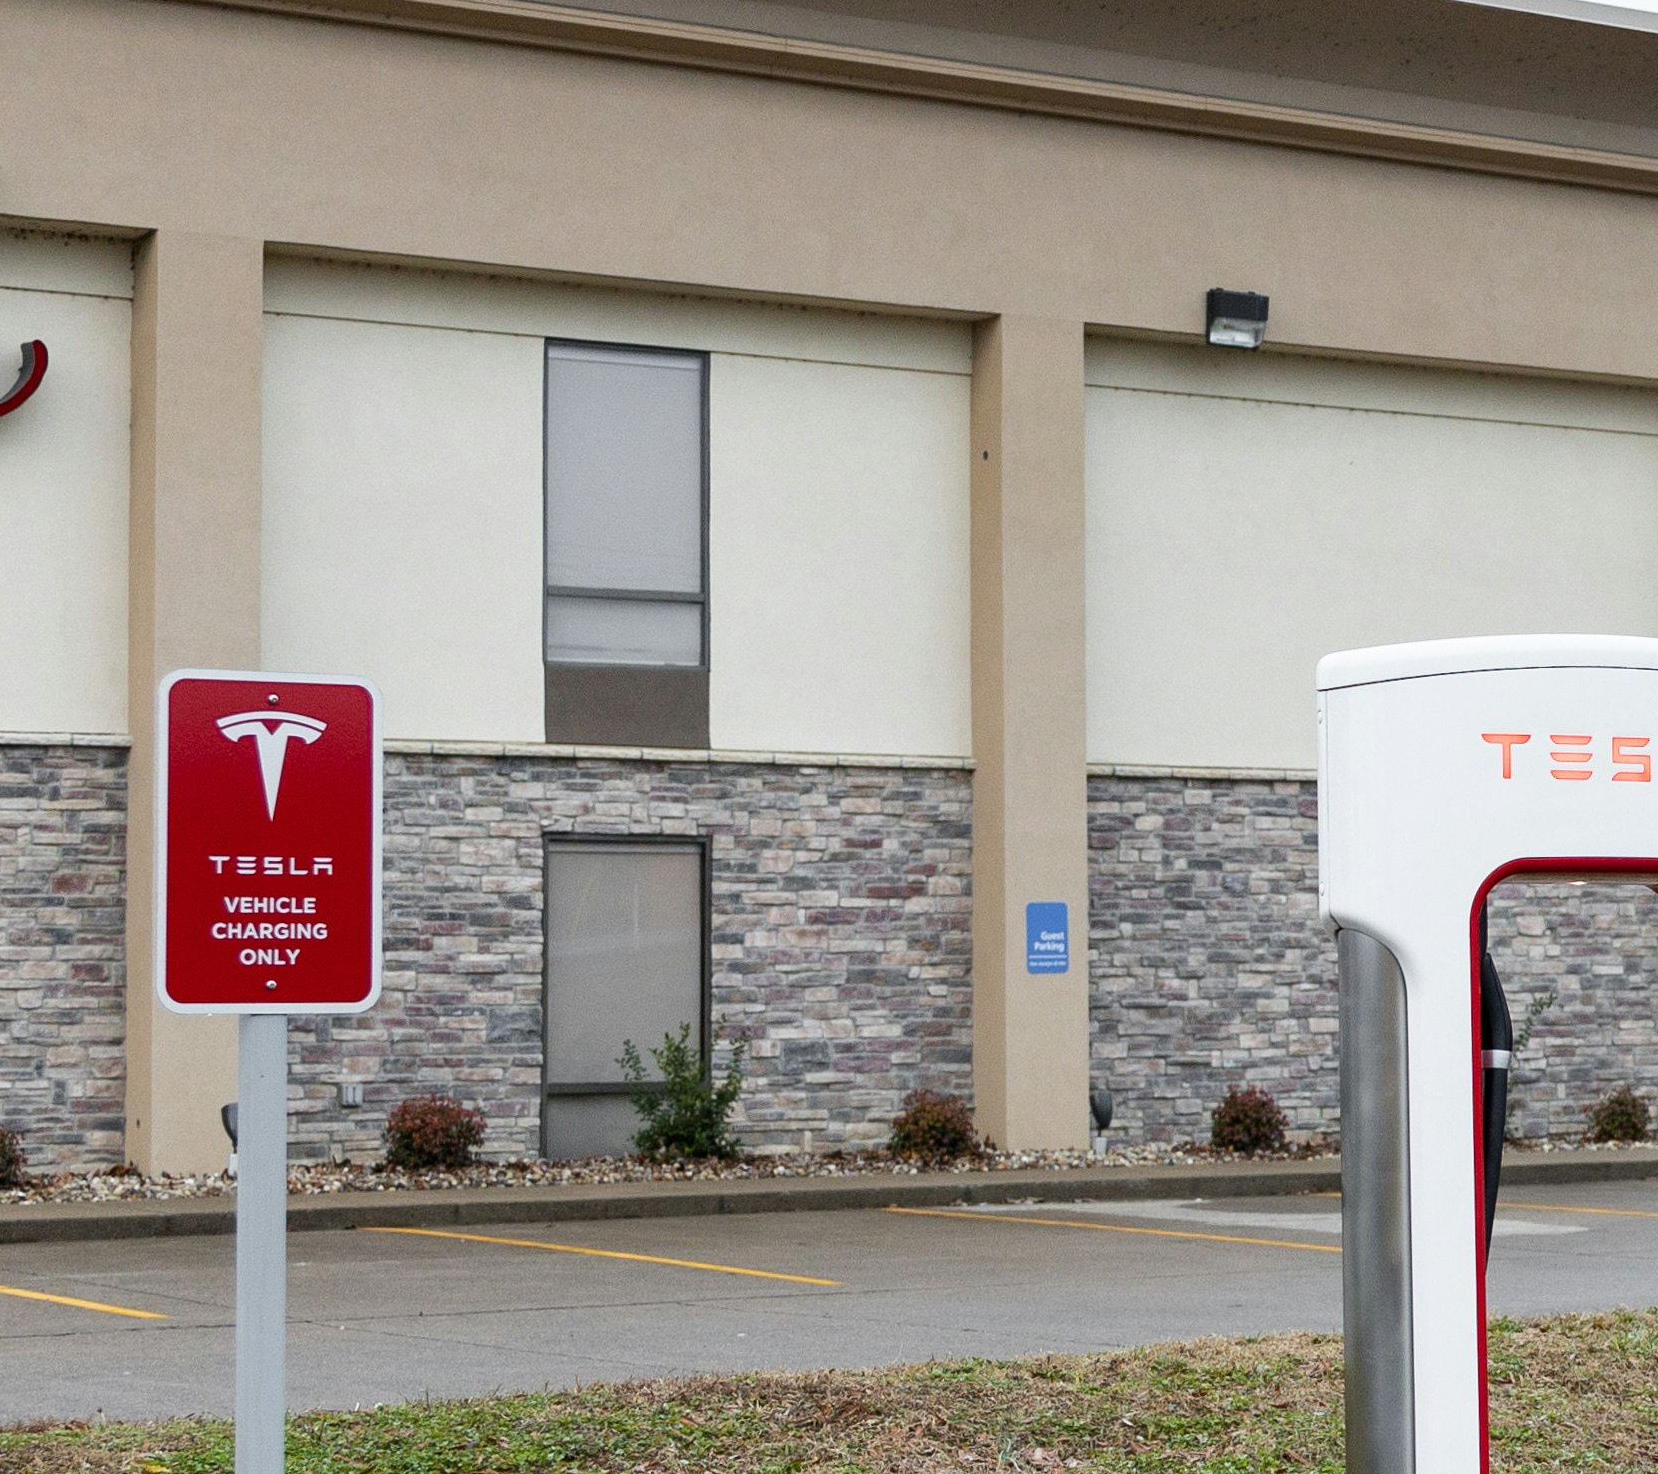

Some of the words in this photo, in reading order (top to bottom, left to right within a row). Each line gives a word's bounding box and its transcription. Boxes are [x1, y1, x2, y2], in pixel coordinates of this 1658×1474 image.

[208, 855, 333, 876] TESLA
[223, 896, 317, 914] VEHICLE
[211, 922, 328, 940] CHARGING
[1034, 941, 1065, 953] Parking
[239, 948, 301, 966] ONLY
